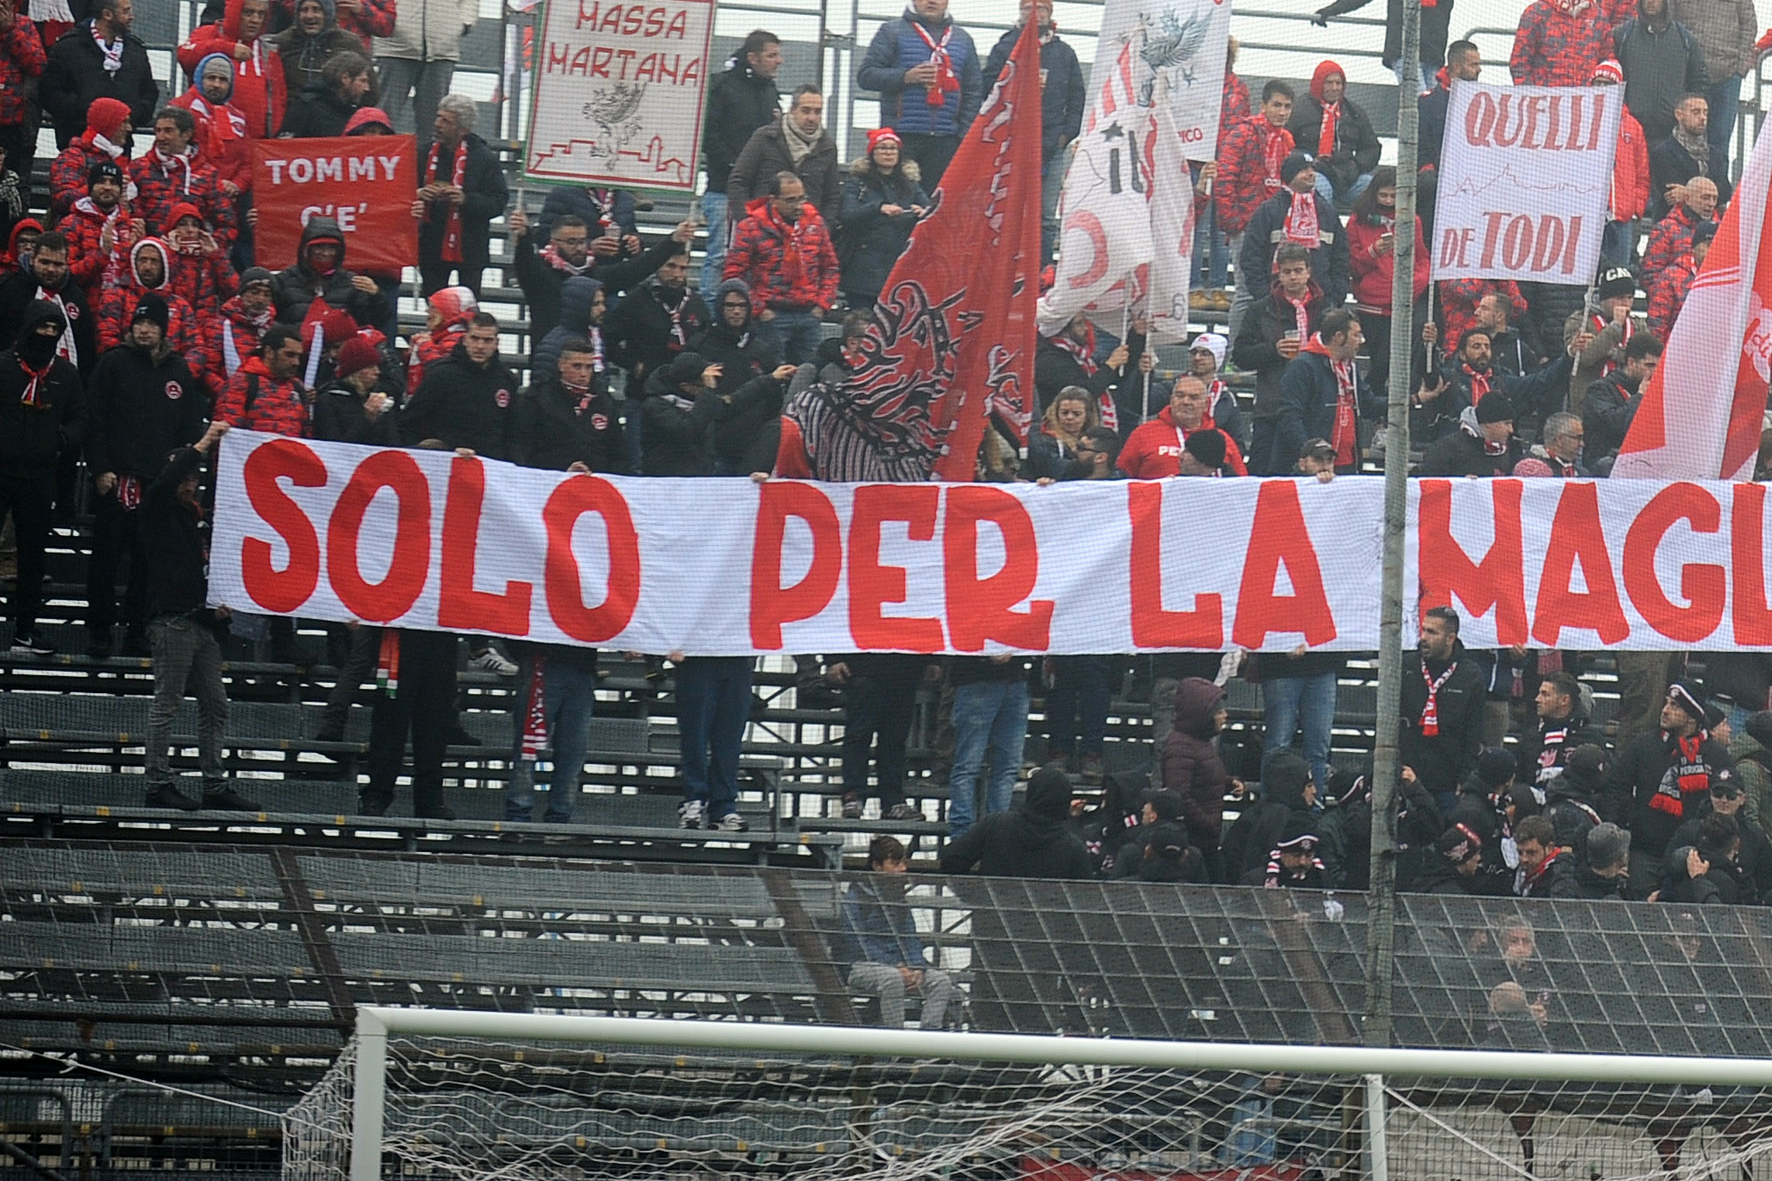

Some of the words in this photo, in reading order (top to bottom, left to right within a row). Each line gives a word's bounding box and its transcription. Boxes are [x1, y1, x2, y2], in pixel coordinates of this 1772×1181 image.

[575, 0, 687, 40] MASSA
[547, 42, 700, 87] MARTANA
[1464, 91, 1606, 151] QUELLI
[264, 155, 401, 185] TOMMY
[1438, 227, 1476, 270] DE
[1479, 211, 1584, 275] TODI
[240, 436, 641, 644] SOLO
[749, 481, 1055, 653] PER
[1127, 479, 1338, 650] LA
